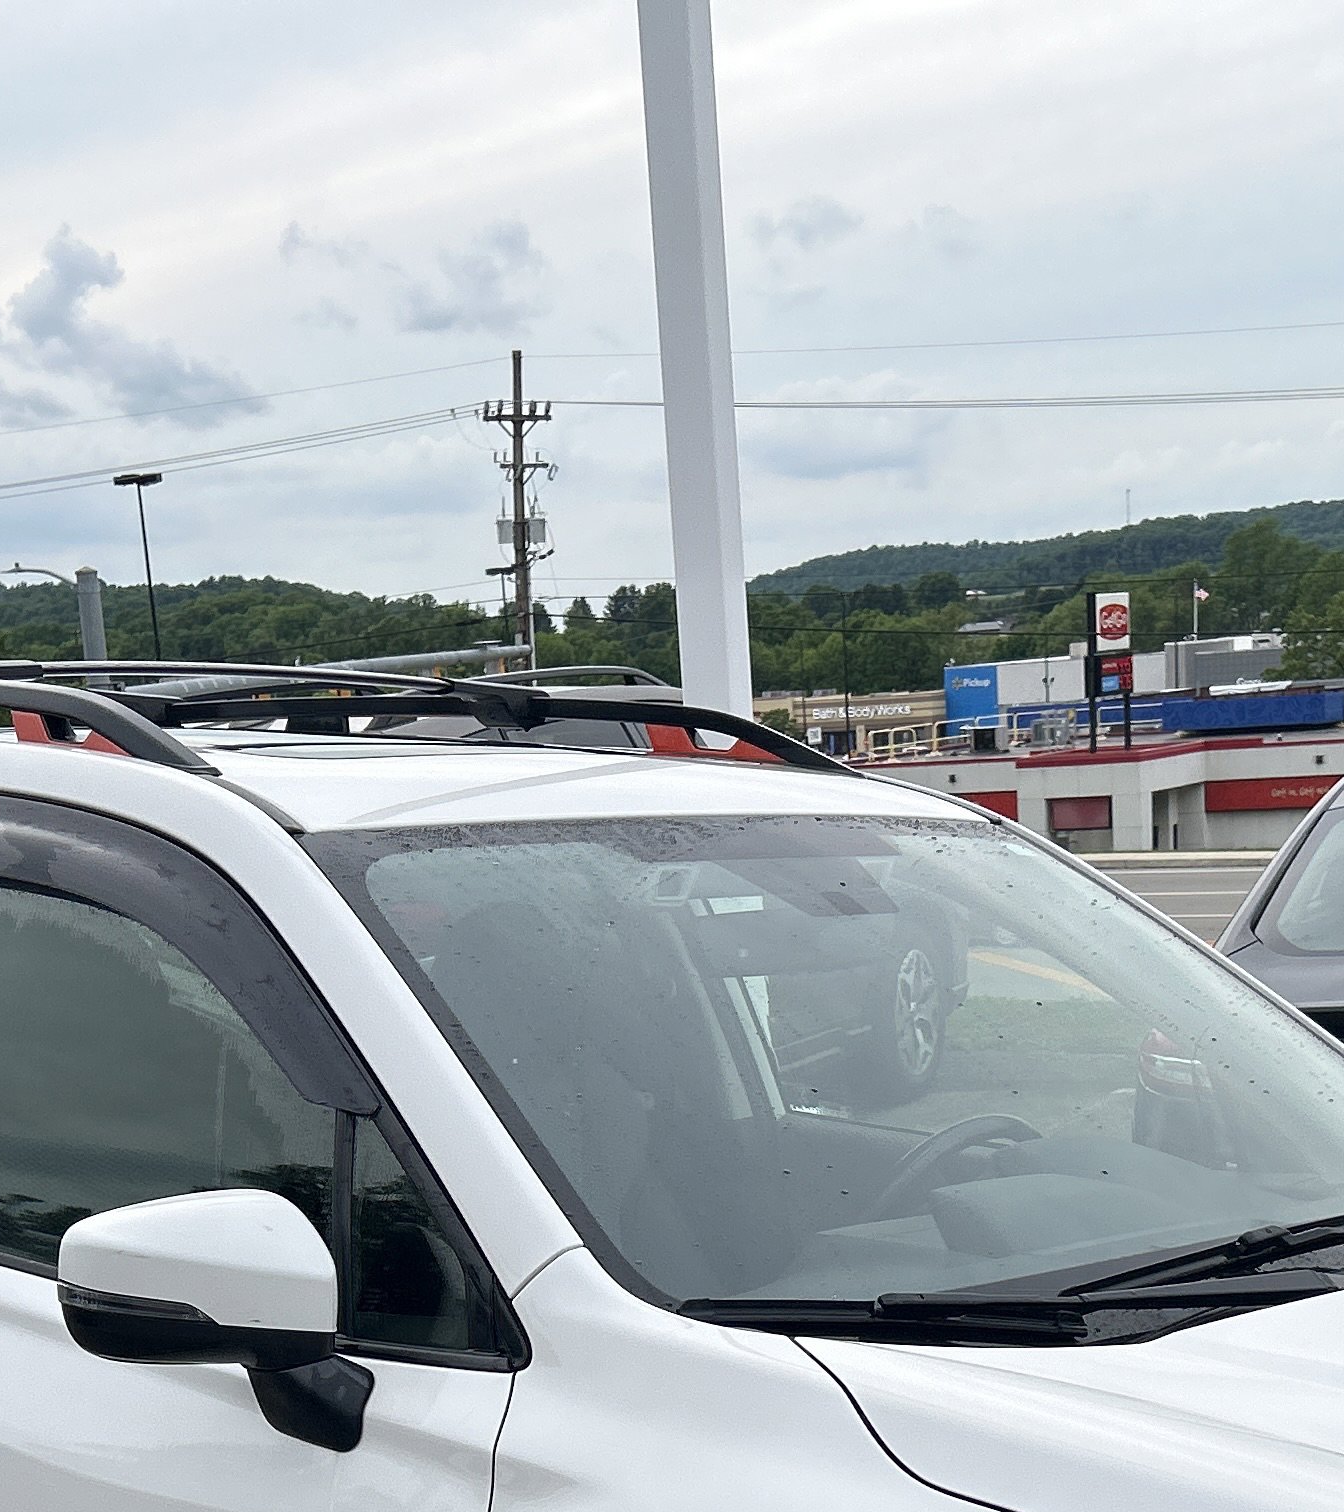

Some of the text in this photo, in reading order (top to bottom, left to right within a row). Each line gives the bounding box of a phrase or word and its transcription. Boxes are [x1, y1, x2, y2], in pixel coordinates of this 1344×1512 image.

[963, 677, 991, 688] Pickup
[812, 704, 912, 719] Bath & Body Works
